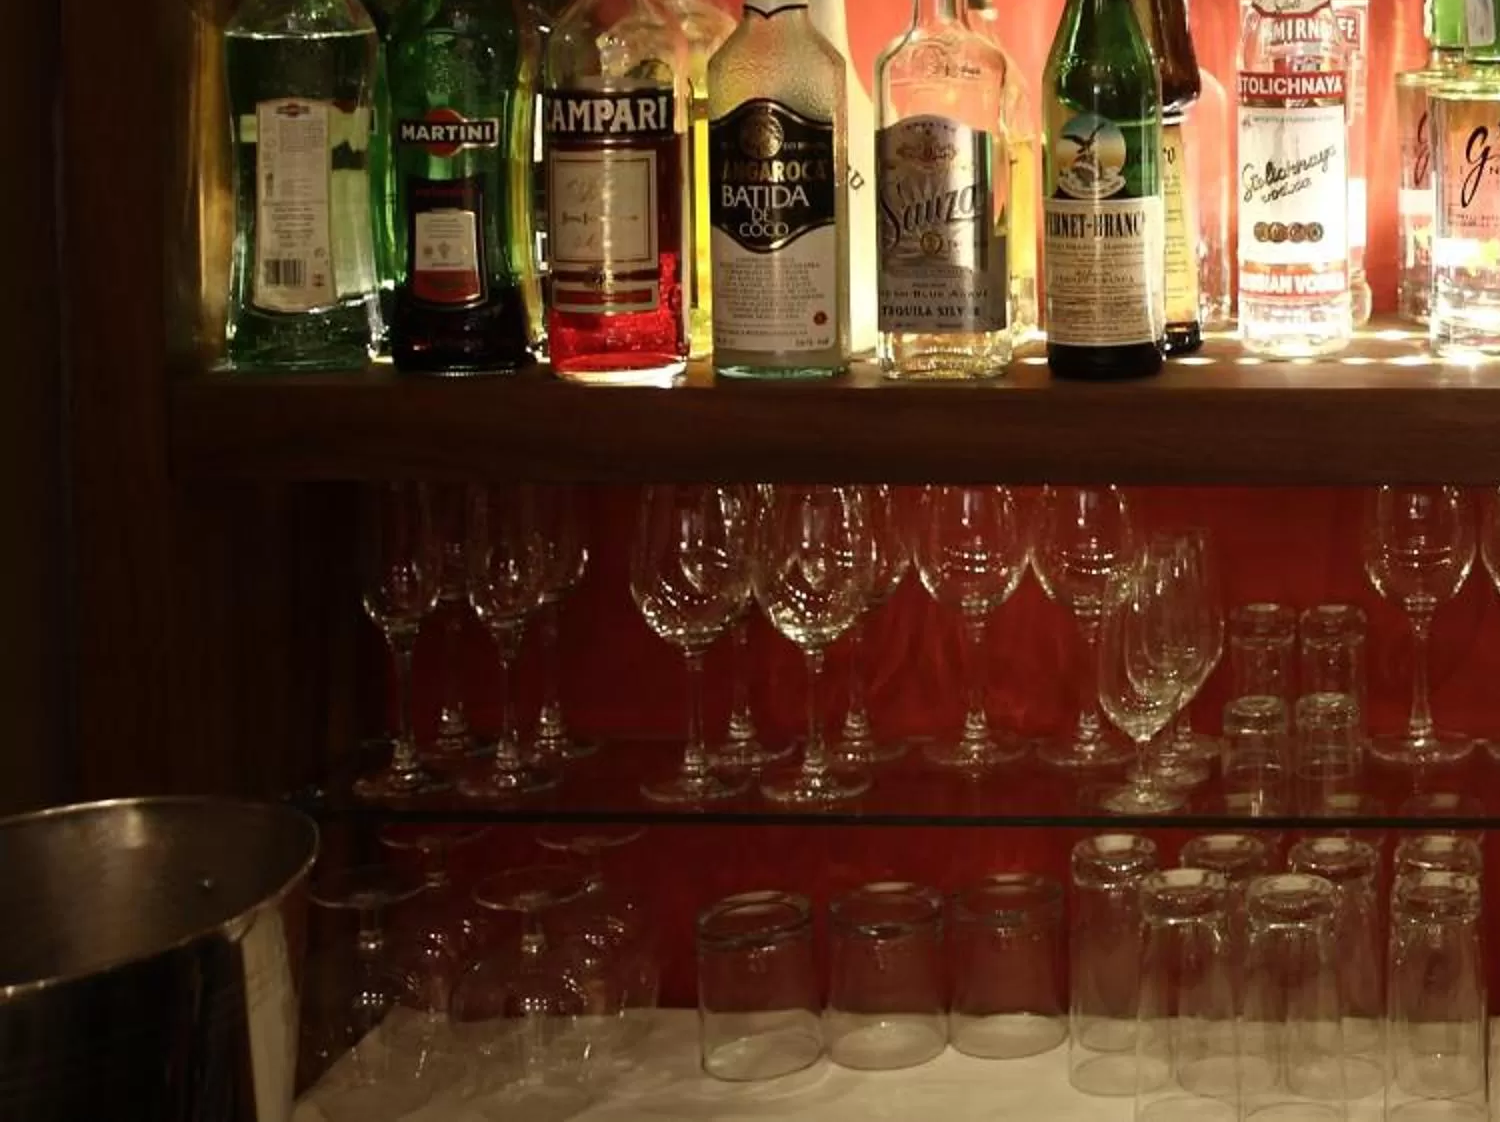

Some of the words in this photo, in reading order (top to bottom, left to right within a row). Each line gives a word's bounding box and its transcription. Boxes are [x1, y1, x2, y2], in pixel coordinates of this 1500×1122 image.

[1262, 16, 1357, 41] SMIRNFF
[550, 96, 668, 133] AMPARI
[401, 124, 493, 141] MARTINI
[722, 184, 811, 209] BATIDA
[739, 221, 790, 238] COCO
[879, 181, 979, 253] Sauza
[882, 305, 933, 318] TEQUILA
[936, 305, 981, 317] SILVR
